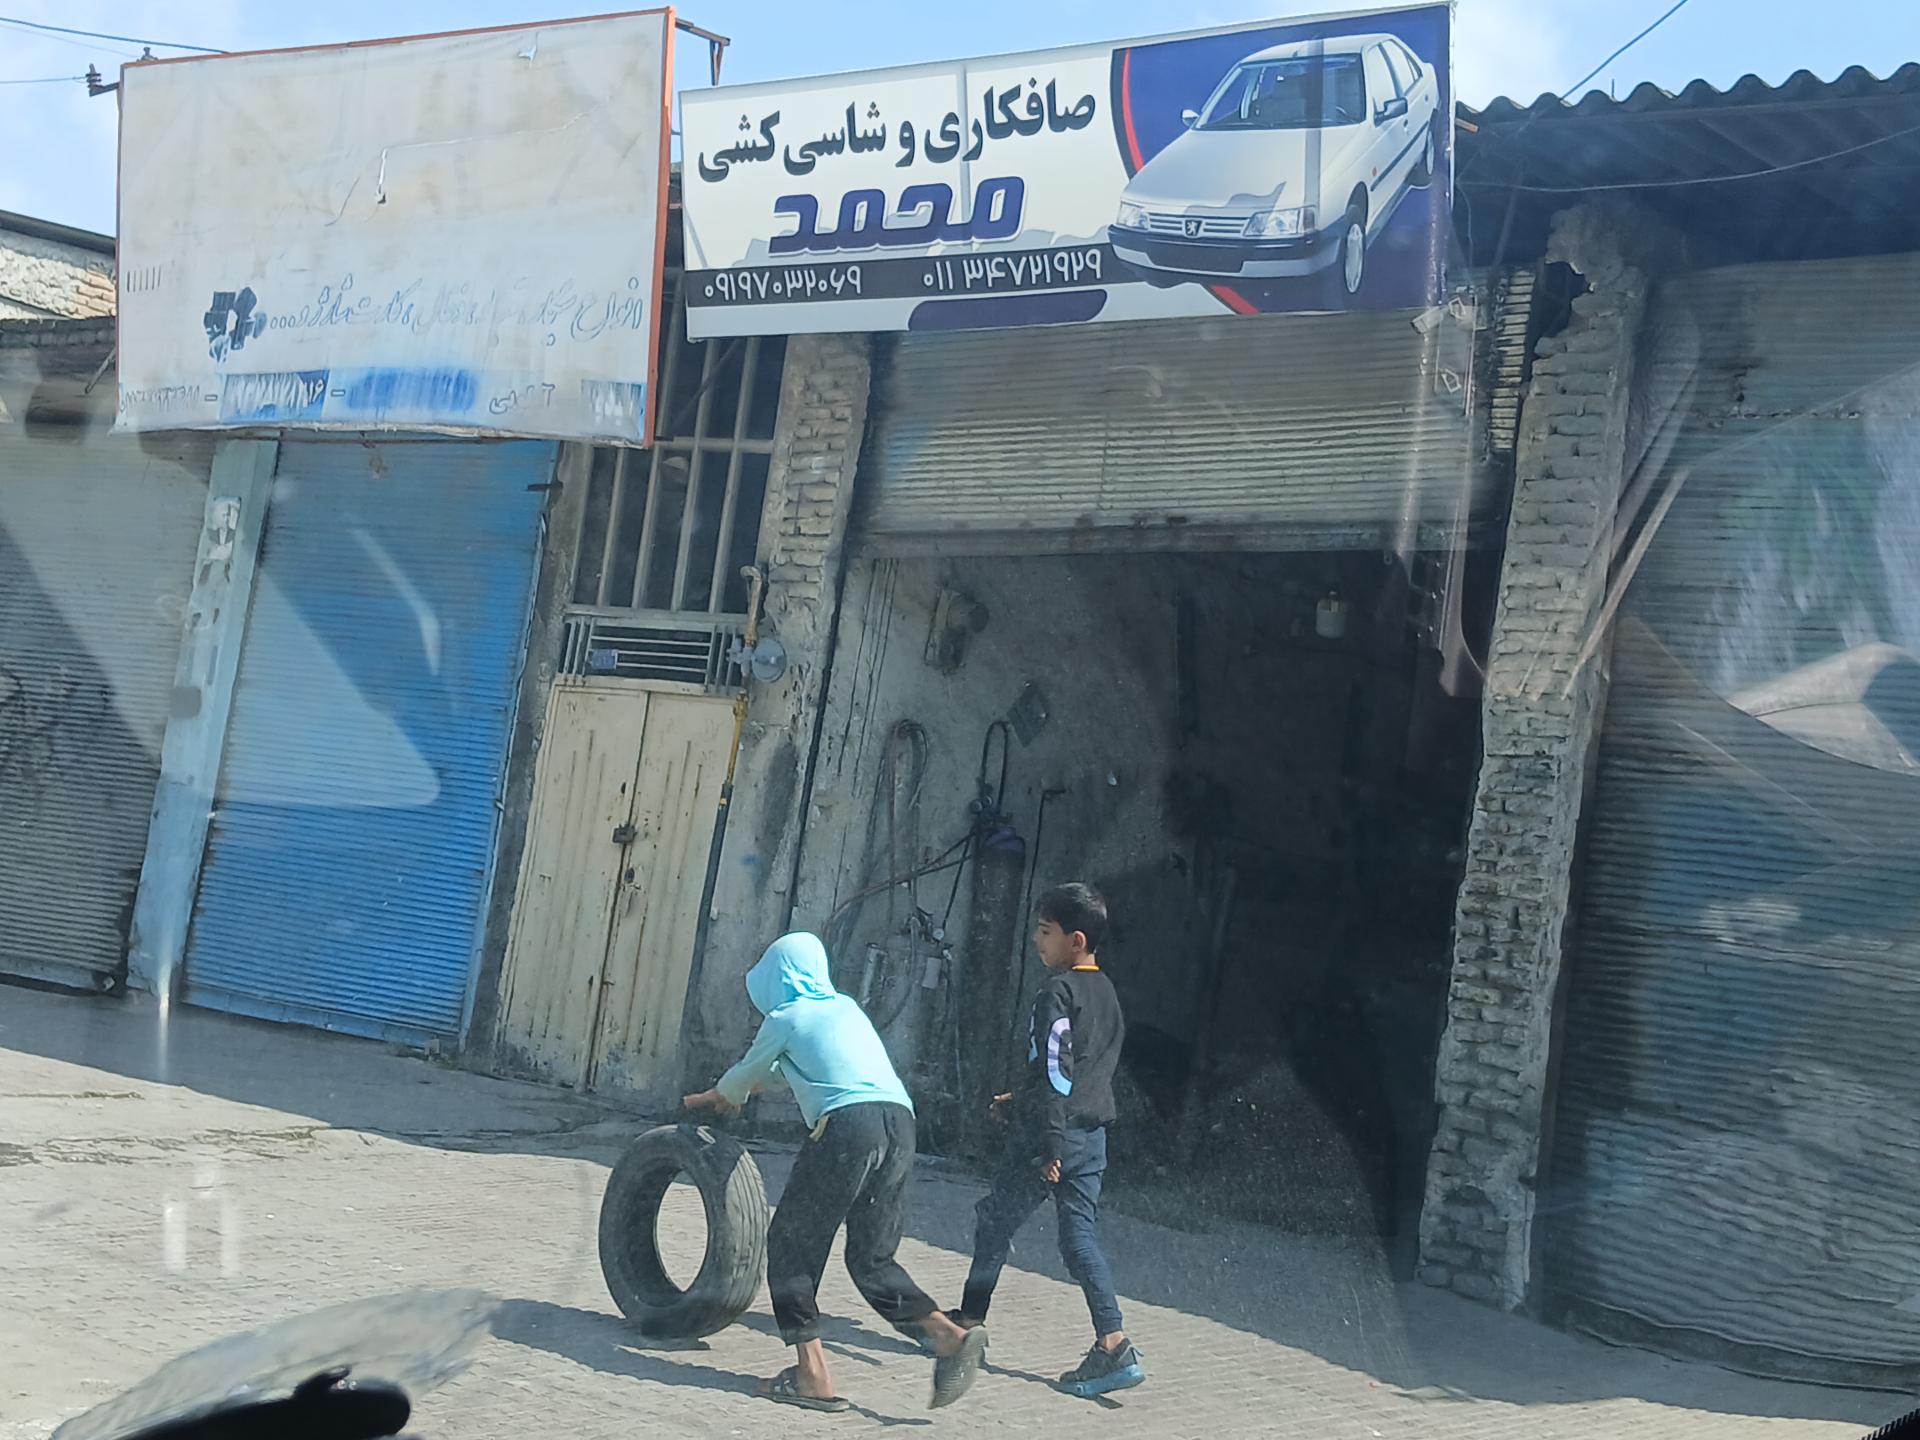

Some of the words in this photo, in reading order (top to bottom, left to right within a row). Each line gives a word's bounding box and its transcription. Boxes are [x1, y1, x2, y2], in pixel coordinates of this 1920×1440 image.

[698, 110, 781, 183] کشی
[783, 101, 887, 176] شاسی
[895, 119, 917, 168] و
[923, 76, 1096, 163] صافکاری
[768, 175, 1026, 256] محمد
[704, 264, 862, 301] ۰۹۱۹۷۰۳۲۰۶۹
[923, 259, 954, 291] ۰۱۱
[962, 248, 1102, 289] ۳۴۷۲۱۹۲۹
